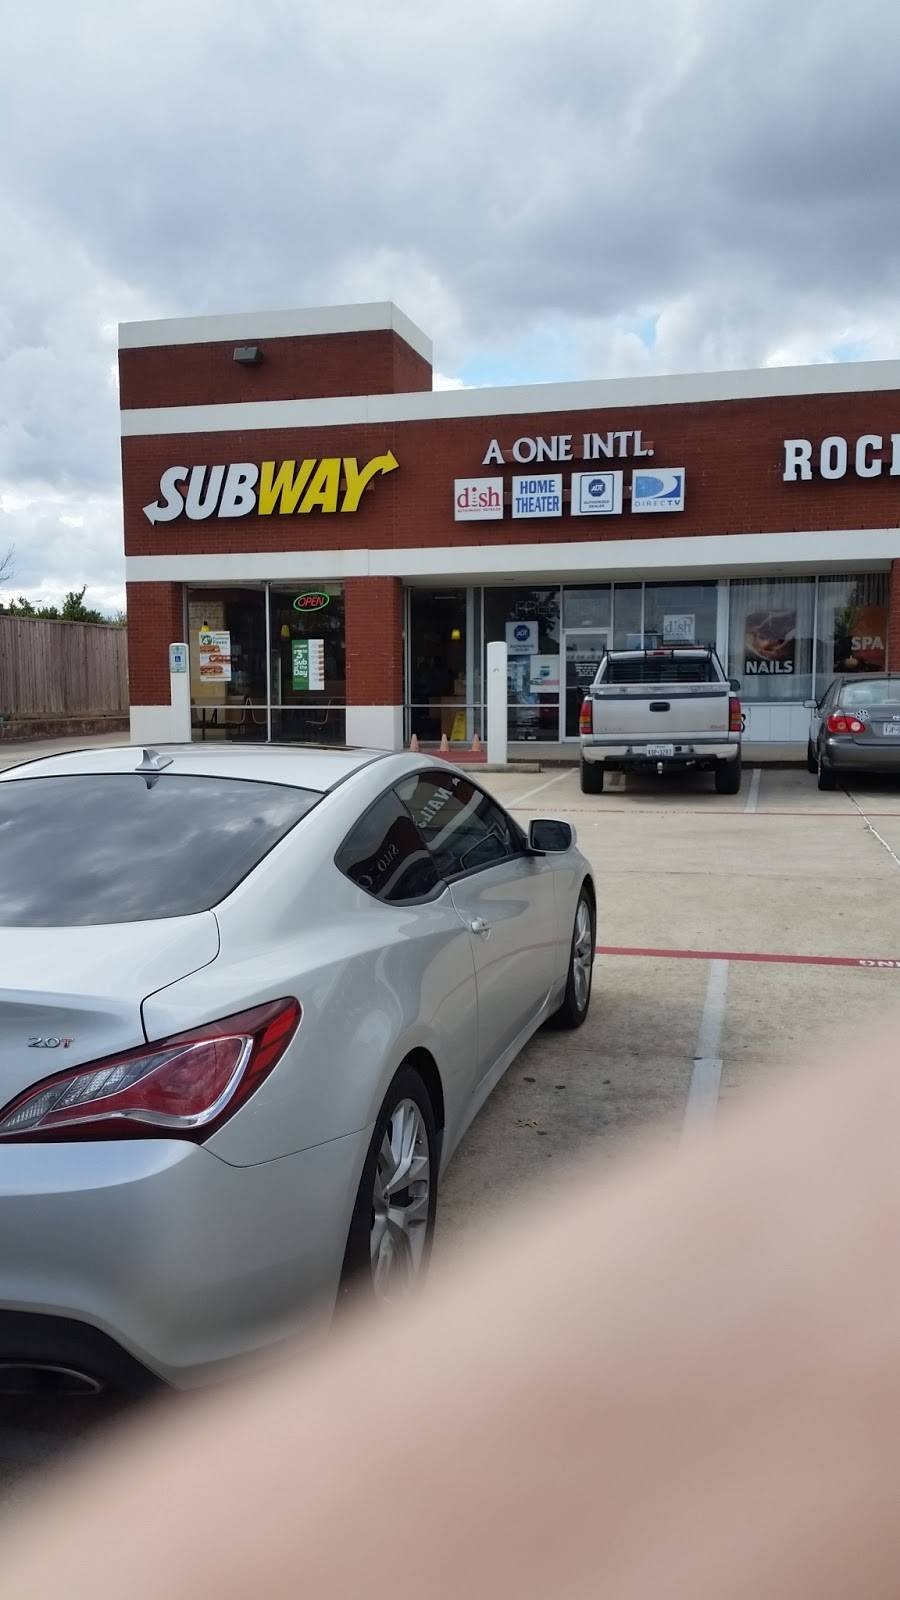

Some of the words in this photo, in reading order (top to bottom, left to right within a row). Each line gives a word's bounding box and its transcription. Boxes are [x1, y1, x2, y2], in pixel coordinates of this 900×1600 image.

[482, 439, 505, 465] A
[512, 434, 574, 463] ONE
[583, 430, 655, 460] INTL.
[142, 450, 399, 525] SUBWAY
[520, 479, 556, 494] HOME
[457, 486, 500, 508] dish
[515, 495, 560, 513] THEATER
[634, 499, 681, 508] DIRECTV
[297, 596, 324, 607] OPEN
[850, 636, 885, 650] SPA
[293, 670, 308, 678] Day
[745, 660, 793, 674] NAILS
